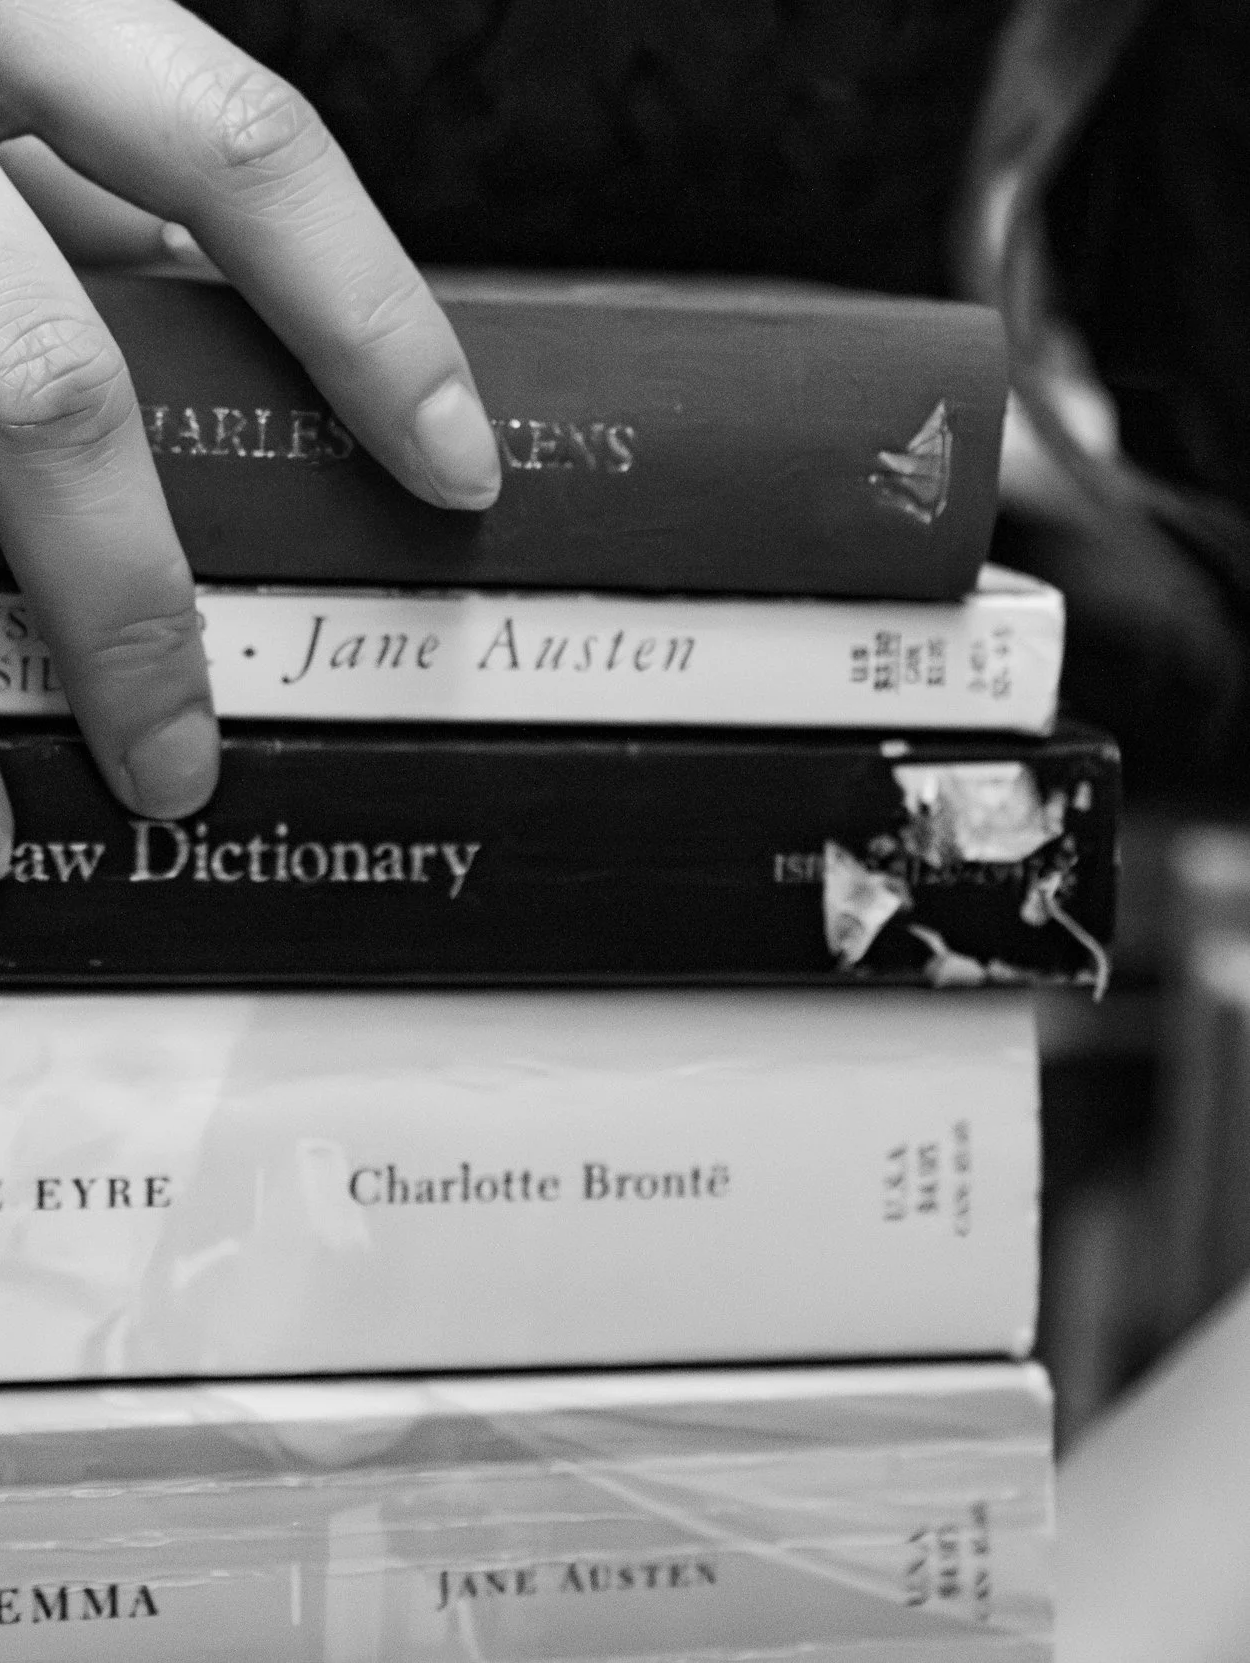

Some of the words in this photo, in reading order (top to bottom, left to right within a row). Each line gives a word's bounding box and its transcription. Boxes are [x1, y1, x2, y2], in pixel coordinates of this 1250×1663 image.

[144, 406, 354, 459] HARLES
[281, 615, 440, 685] Jane
[477, 616, 695, 673] Austen
[12, 841, 105, 883] aw
[129, 819, 481, 899] Dictionary
[34, 1175, 171, 1211] EYRE
[348, 1161, 561, 1206] Charlotte
[582, 1161, 730, 1201] Brontë
[436, 1570, 538, 1612] JANE
[558, 1560, 718, 1594] AUSTEN
